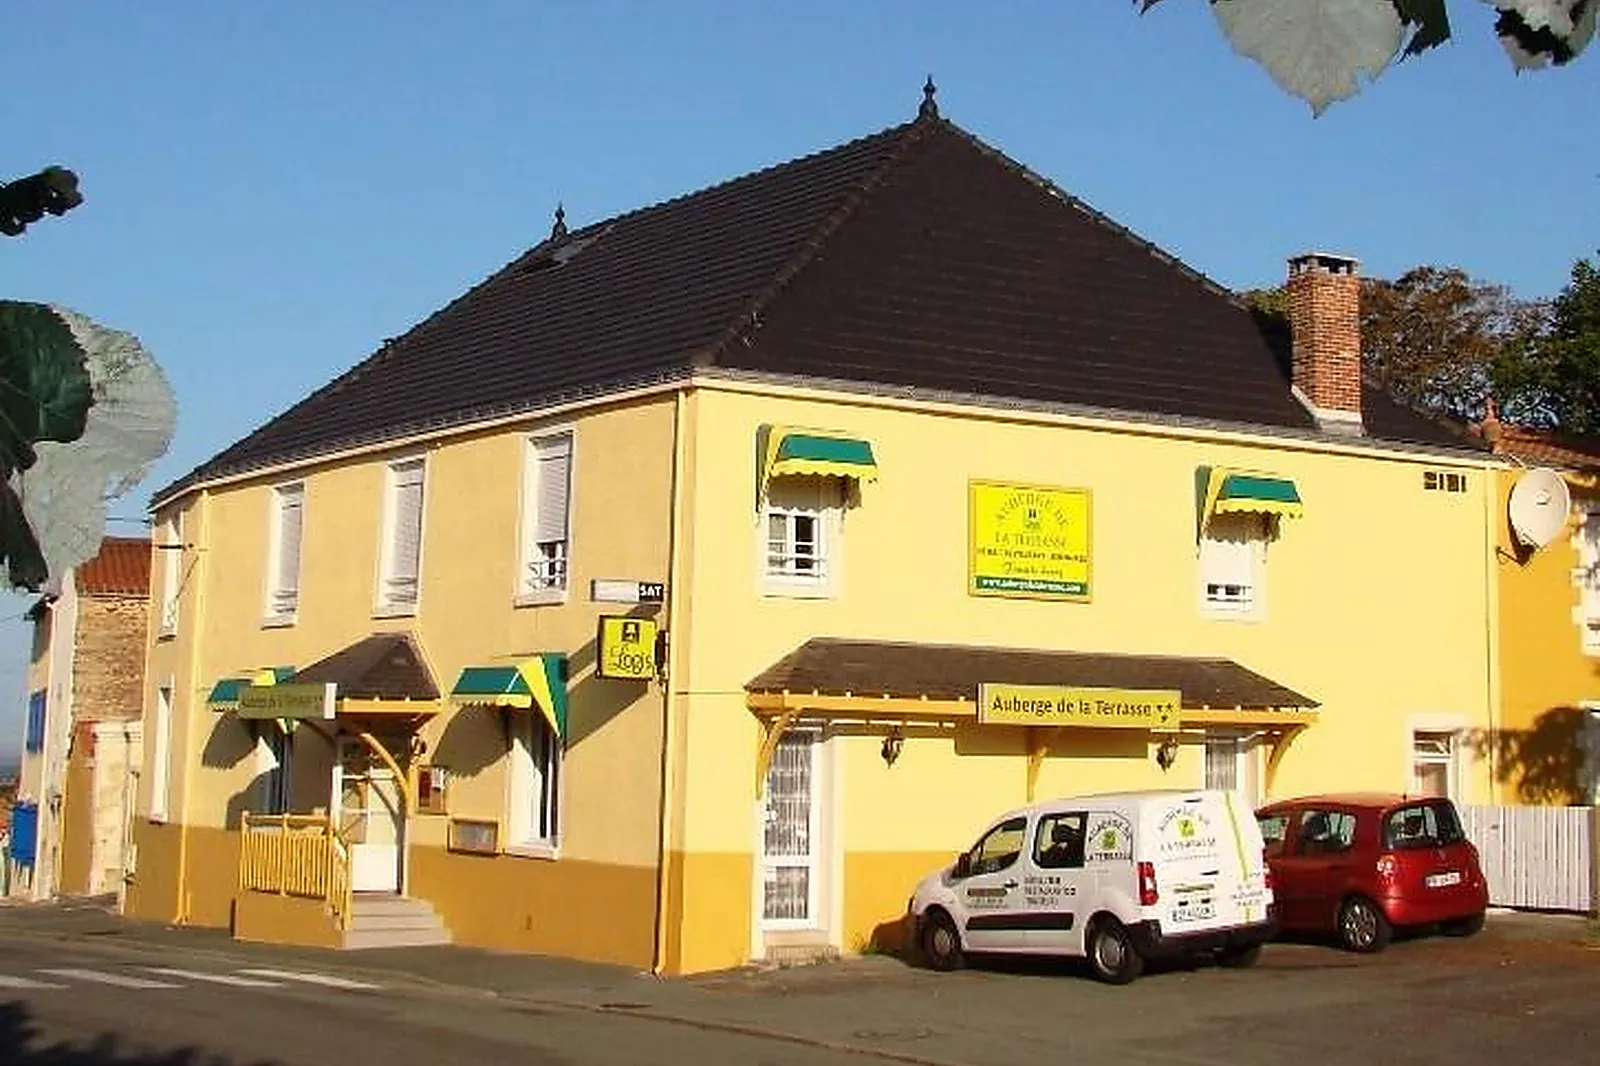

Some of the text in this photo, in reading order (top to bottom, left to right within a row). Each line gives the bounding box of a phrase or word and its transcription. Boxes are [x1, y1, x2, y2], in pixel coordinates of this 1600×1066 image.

[992, 695, 1151, 717] Auberge de la Terrasse
